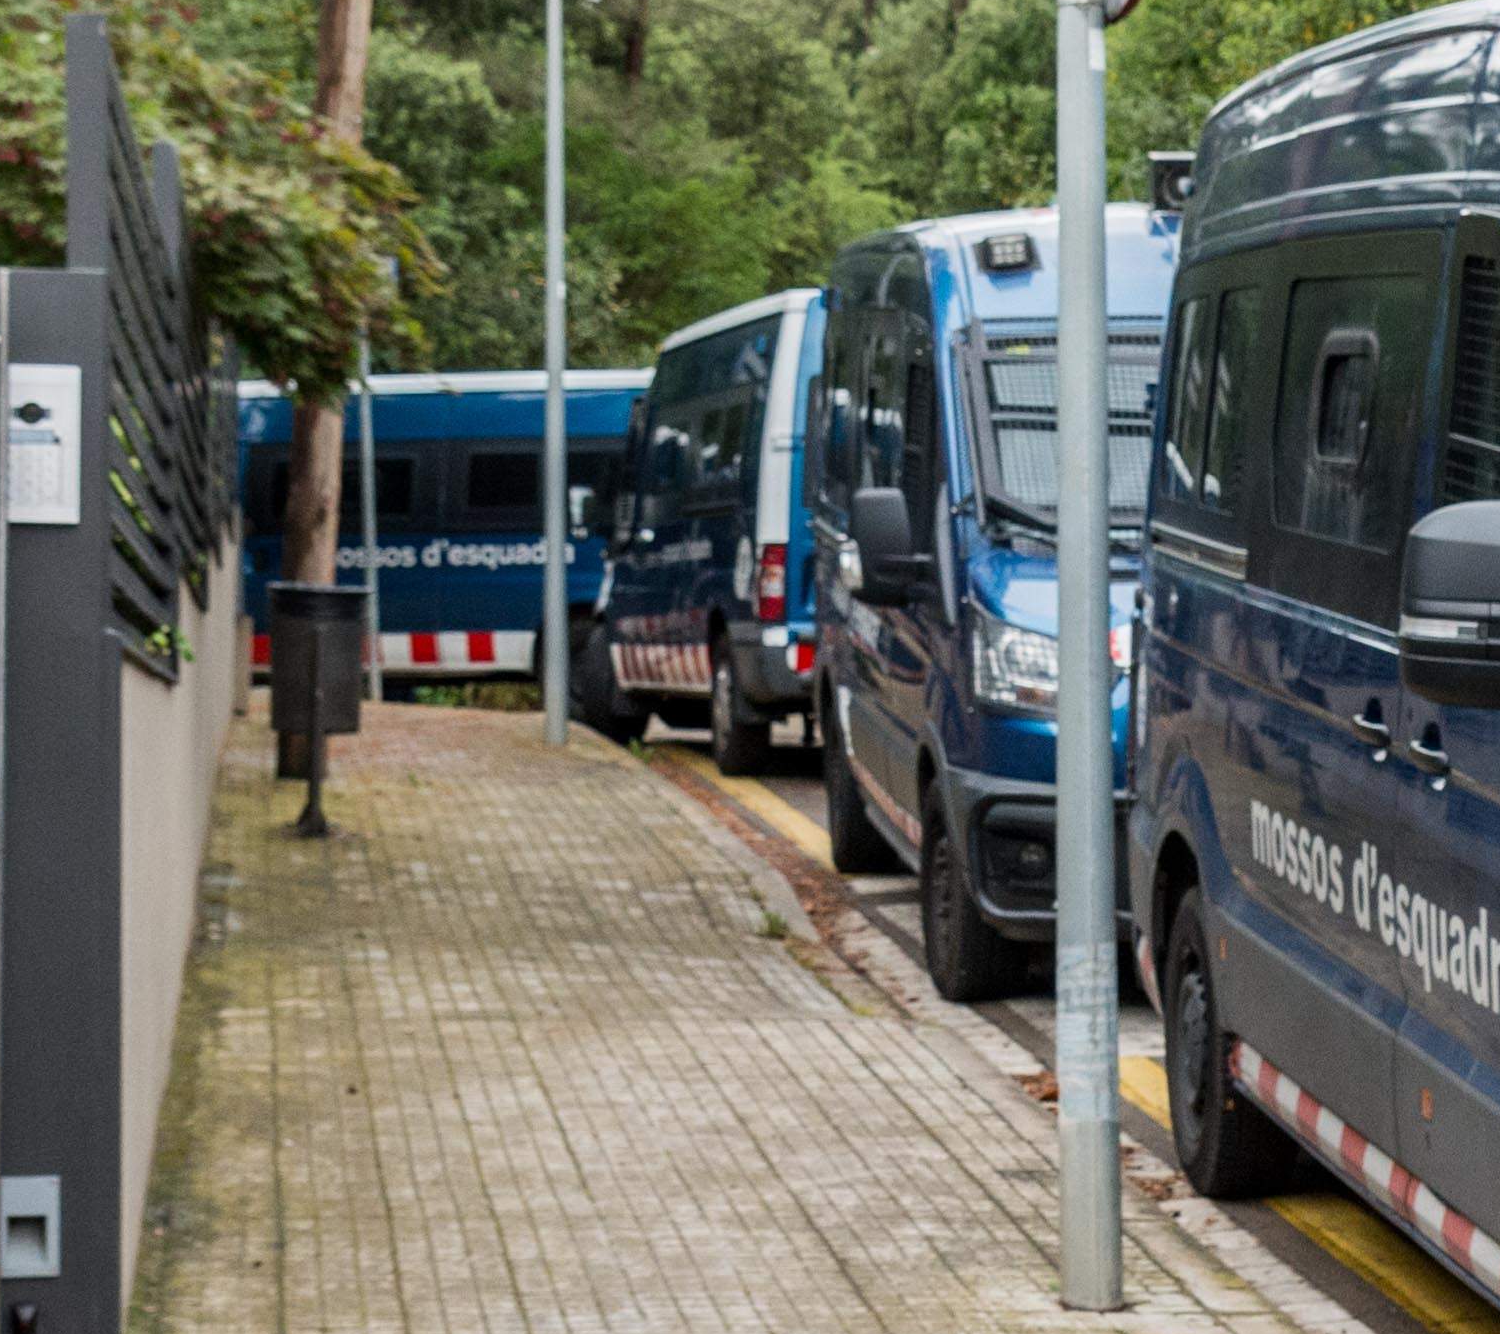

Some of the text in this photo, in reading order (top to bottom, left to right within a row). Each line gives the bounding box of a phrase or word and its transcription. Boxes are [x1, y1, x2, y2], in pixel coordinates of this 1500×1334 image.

[337, 537, 575, 570] ossos d'esquada
[1251, 800, 1344, 914] mossos
